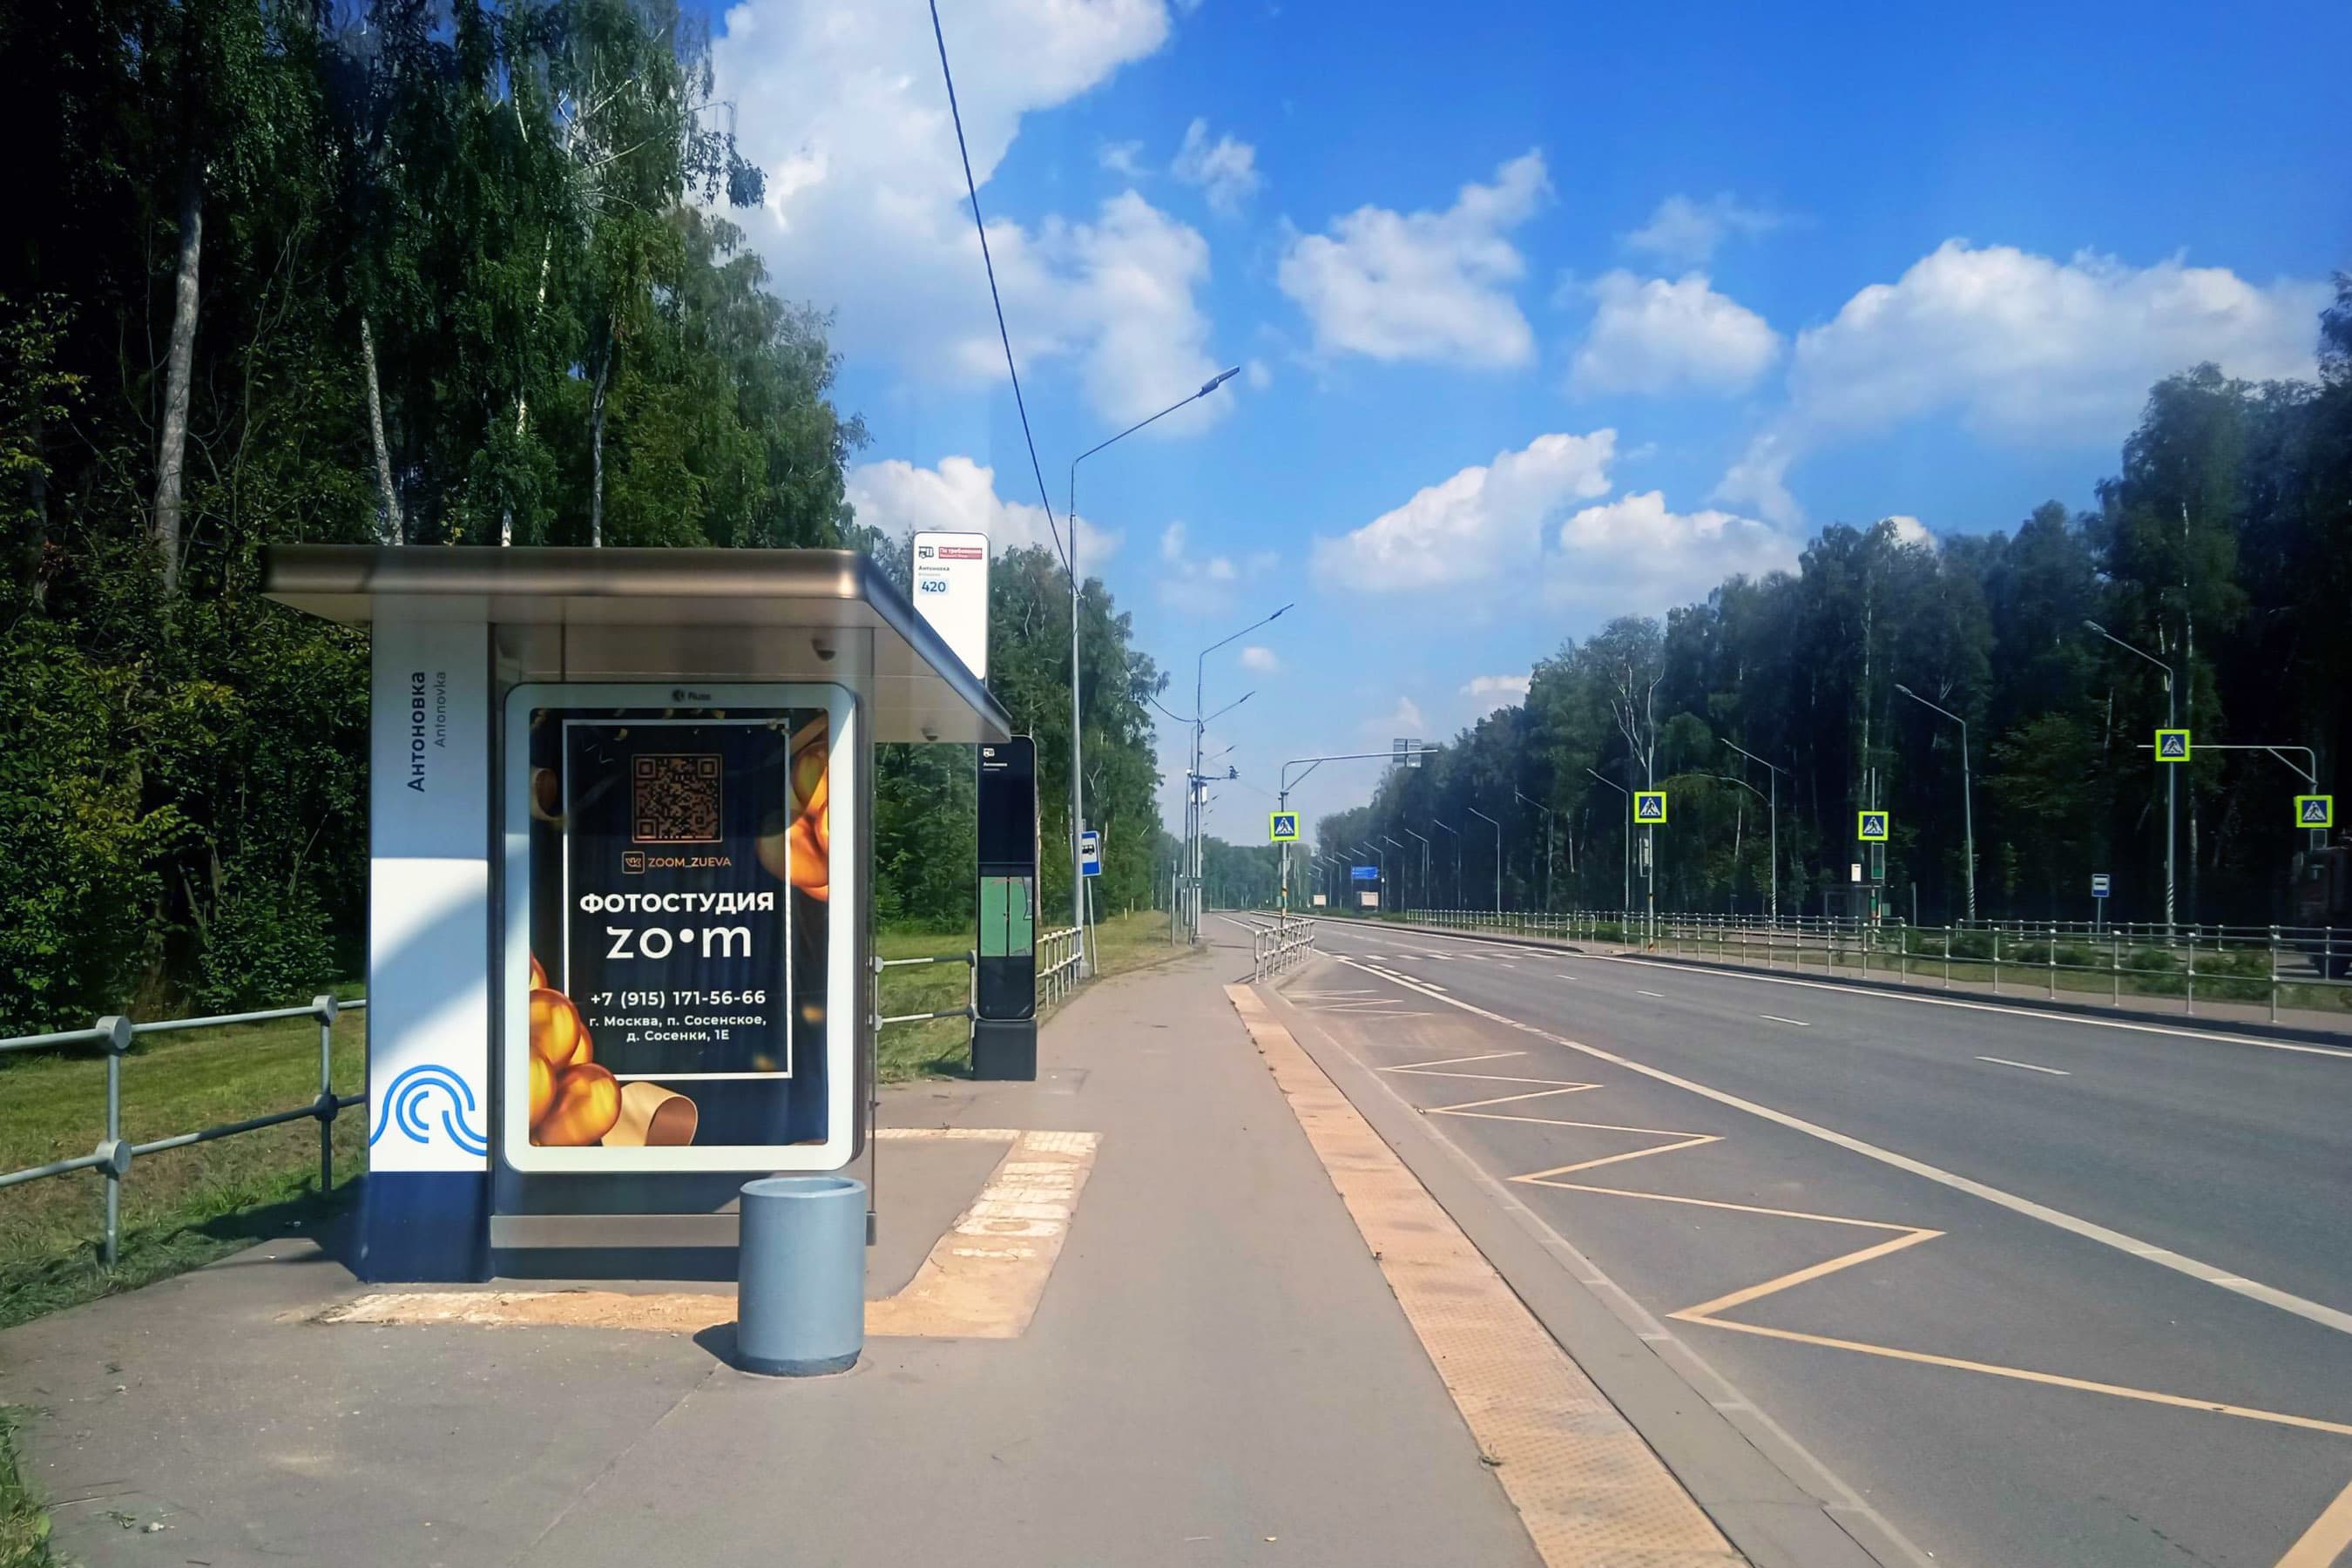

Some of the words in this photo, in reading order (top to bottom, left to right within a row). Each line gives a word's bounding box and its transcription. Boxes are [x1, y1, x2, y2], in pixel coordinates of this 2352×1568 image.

[922, 581, 947, 592] 420
[434, 671, 446, 747] Antonovka
[407, 671, 426, 793] Антоновка
[647, 856, 732, 868] ZOOM_ZUEVA
[579, 891, 774, 916] ФОТОСТУДИЯ
[591, 992, 613, 1006] +7
[620, 990, 666, 1009] (915)
[672, 990, 767, 1005] 171-56-66
[589, 1018, 599, 1027] г.
[604, 1016, 663, 1028] Москва,
[667, 1017, 679, 1026] п.
[684, 1015, 767, 1027] Сосенское,
[626, 1032, 639, 1043] д.
[644, 1031, 711, 1043] Сосенки,
